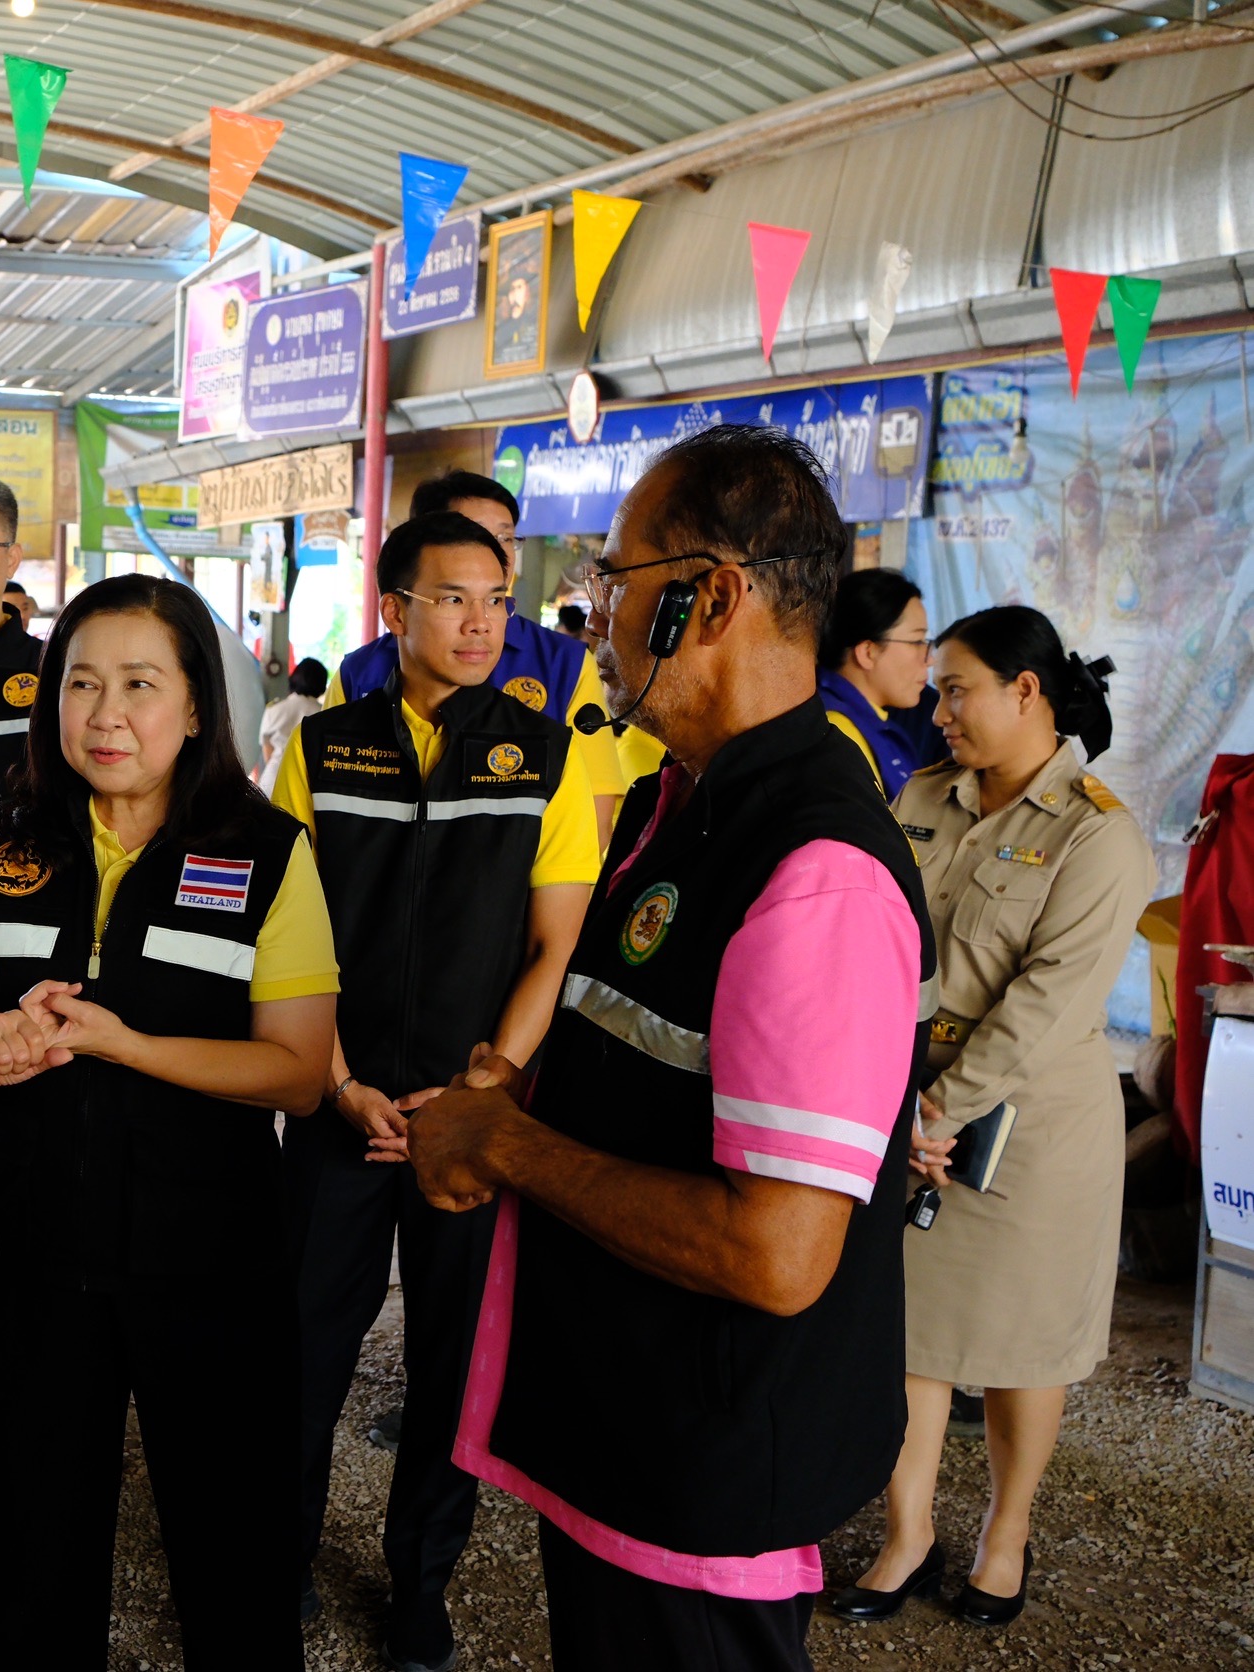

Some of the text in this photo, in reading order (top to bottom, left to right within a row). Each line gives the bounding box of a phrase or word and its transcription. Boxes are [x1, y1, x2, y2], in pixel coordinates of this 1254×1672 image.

[471, 769, 540, 783] กระทรวงมหาดไทย
[180, 893, 242, 909] THAILAND
